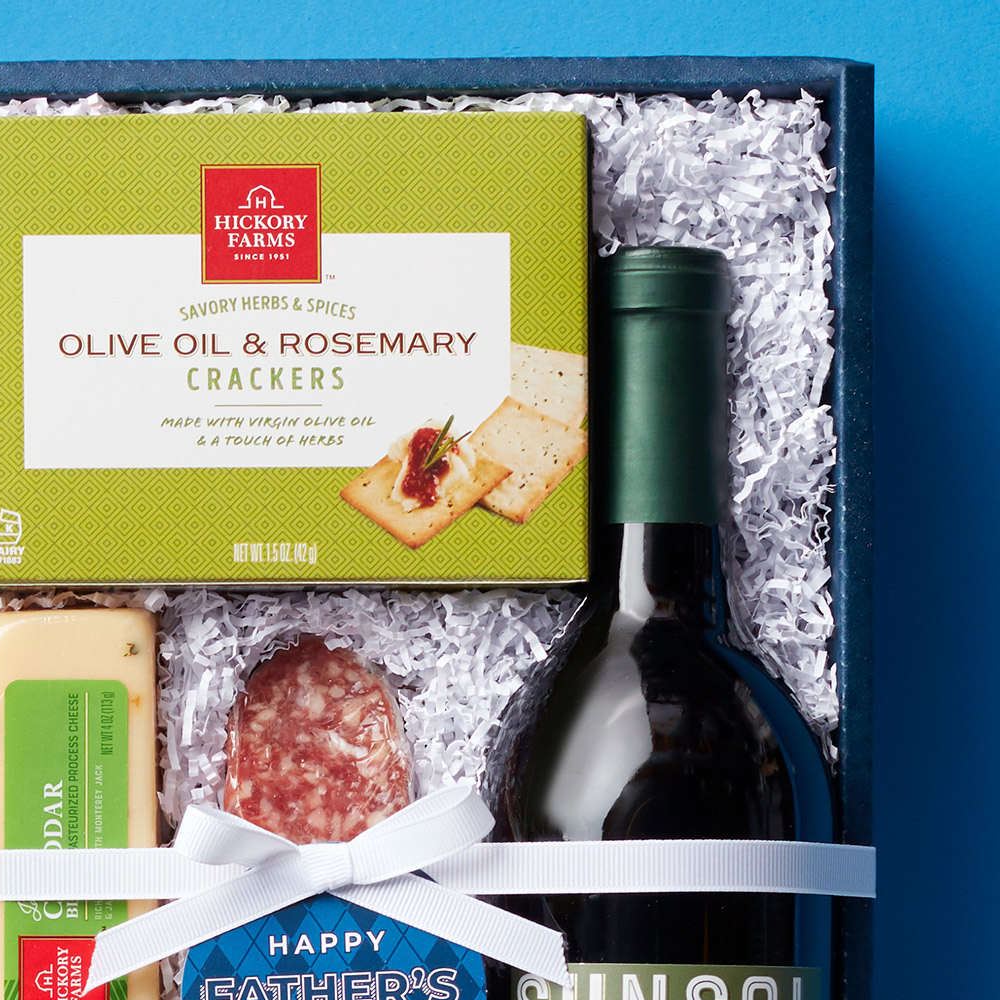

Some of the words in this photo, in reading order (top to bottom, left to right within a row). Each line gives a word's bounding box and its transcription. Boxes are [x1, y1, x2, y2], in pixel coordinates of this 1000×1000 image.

[214, 214, 308, 230] HICKORY
[227, 232, 296, 248] FARMS
[233, 253, 265, 261] SINCE
[268, 253, 290, 261] 1951
[179, 297, 237, 321] SAVORY
[241, 295, 289, 311] HERBS
[292, 297, 302, 311] &
[306, 298, 357, 321] SPICES
[58, 333, 161, 357] OLIVE
[173, 333, 231, 356] OIL
[242, 333, 267, 356] &
[279, 332, 478, 356] ROSEMARY
[187, 366, 345, 391] CRACKERS
[160, 416, 203, 428] MADE
[206, 416, 244, 428] WITH
[248, 416, 300, 428] VIRGIN
[303, 416, 347, 428] OLIVE
[350, 415, 377, 427] OIL
[196, 436, 206, 446] &
[210, 436, 221, 447] A
[224, 435, 272, 447] TOUCH
[275, 435, 297, 447] OF
[298, 435, 345, 447] HERBS
[233, 543, 248, 562] NET
[266, 543, 278, 562] 1.5
[294, 543, 307, 565] (42
[308, 543, 318, 565] g)
[100, 691, 115, 699] g)
[68, 693, 79, 732] CHEESE
[100, 699, 115, 714] (113
[101, 715, 113, 724] OZ
[101, 731, 114, 742] WT
[101, 742, 114, 755] NET
[68, 735, 79, 782] PROCESS
[94, 764, 103, 786] JACK
[68, 785, 79, 850] ASTEURIZED
[94, 789, 103, 833] MONTEREY
[269, 930, 386, 956] HAPPY
